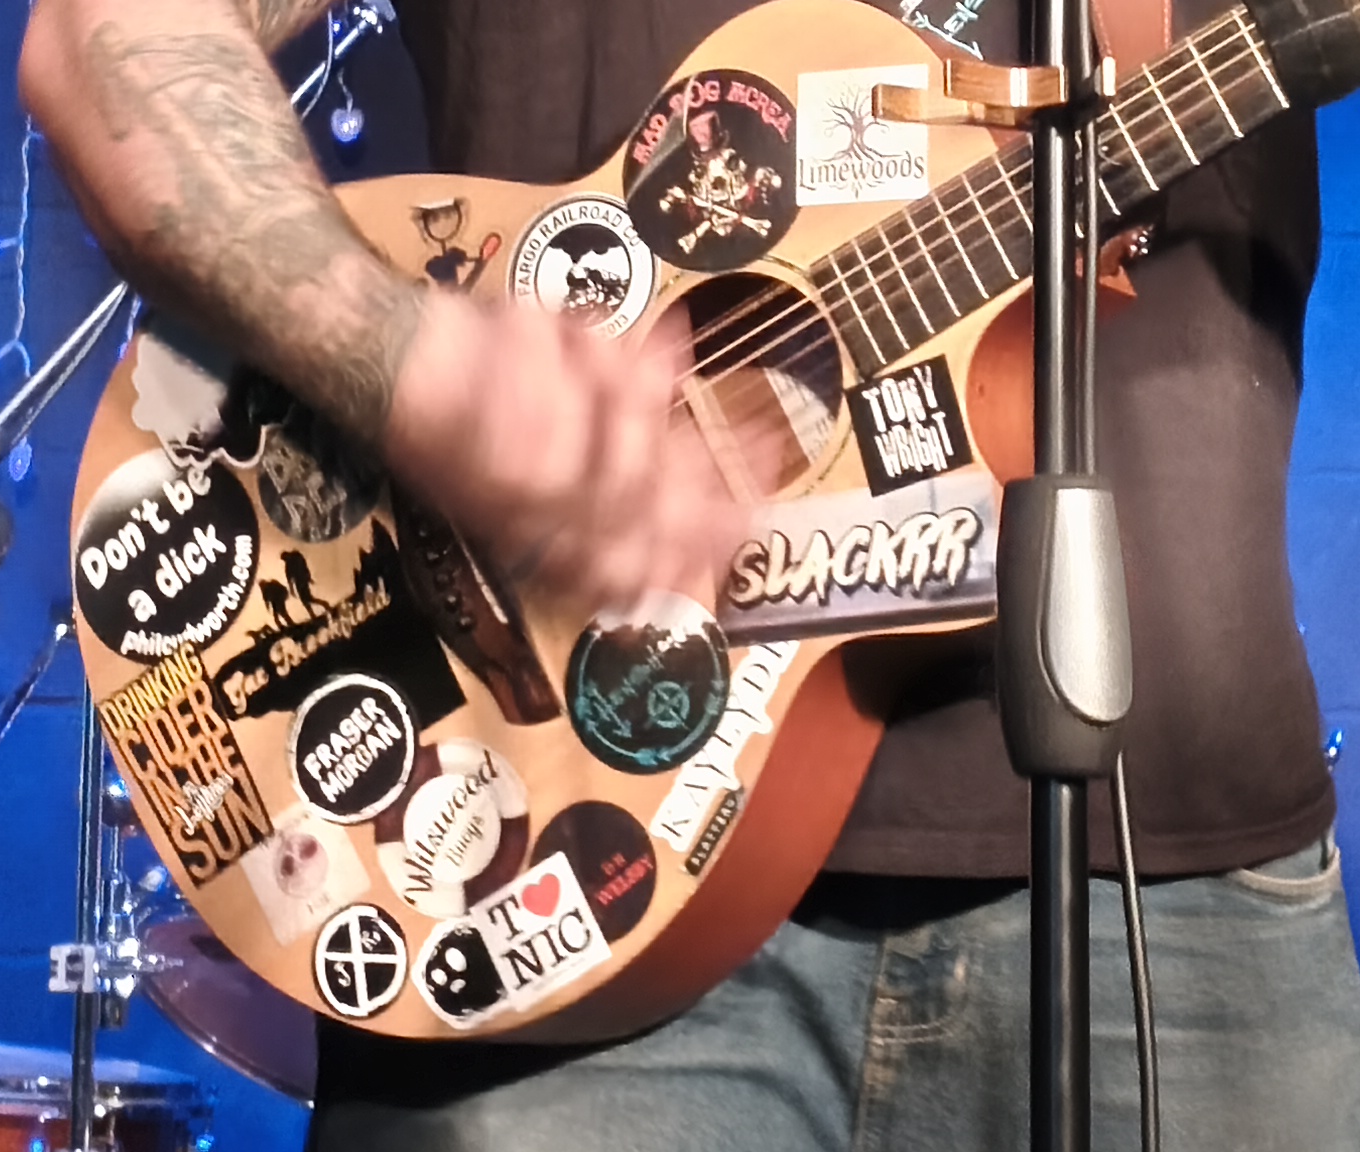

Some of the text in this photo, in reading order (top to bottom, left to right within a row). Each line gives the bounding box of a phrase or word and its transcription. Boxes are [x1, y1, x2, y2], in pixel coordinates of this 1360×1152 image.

[539, 205, 623, 240] RAILROAD
[862, 364, 939, 433] TONY
[874, 410, 954, 479] WRIGHT
[80, 498, 171, 590] Don't
[162, 462, 212, 516] be
[726, 506, 983, 609] SLACKRR
[126, 523, 228, 623] a dick
[99, 641, 204, 737] DRINKING
[118, 679, 230, 780] CIDER
[166, 731, 245, 790] THE
[303, 696, 387, 783] FRASER
[319, 714, 402, 804] MORGAN
[170, 766, 276, 880] SUN
[501, 906, 593, 990] NIC
